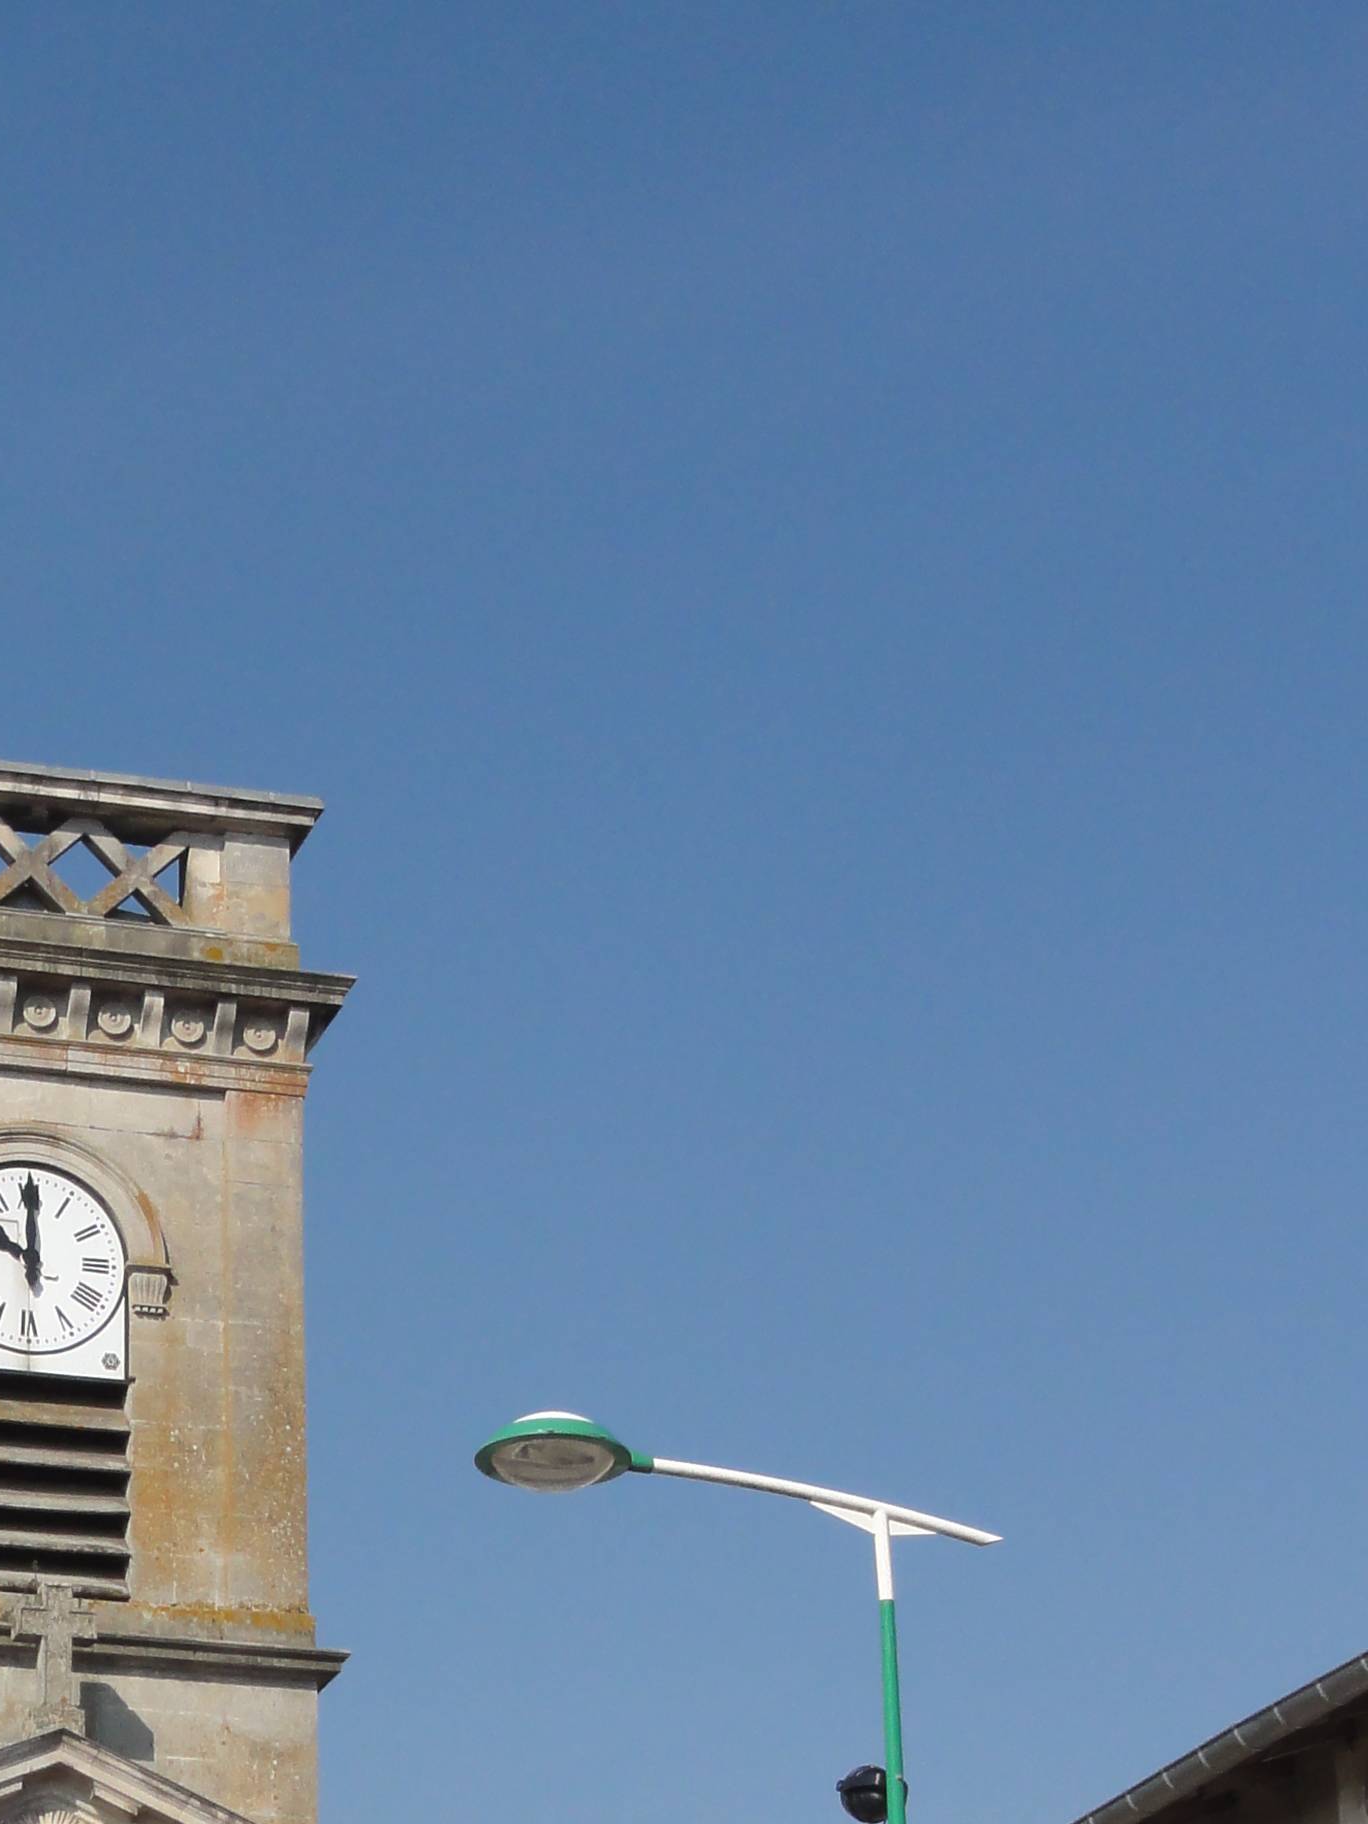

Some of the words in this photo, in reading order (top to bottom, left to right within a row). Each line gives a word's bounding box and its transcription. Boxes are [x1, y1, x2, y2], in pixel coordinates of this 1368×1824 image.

[74, 1224, 100, 1242] II
[82, 1257, 109, 1274] III
[71, 1282, 103, 1312] IIII
[21, 1309, 37, 1337] VI
[55, 1306, 74, 1332] V
